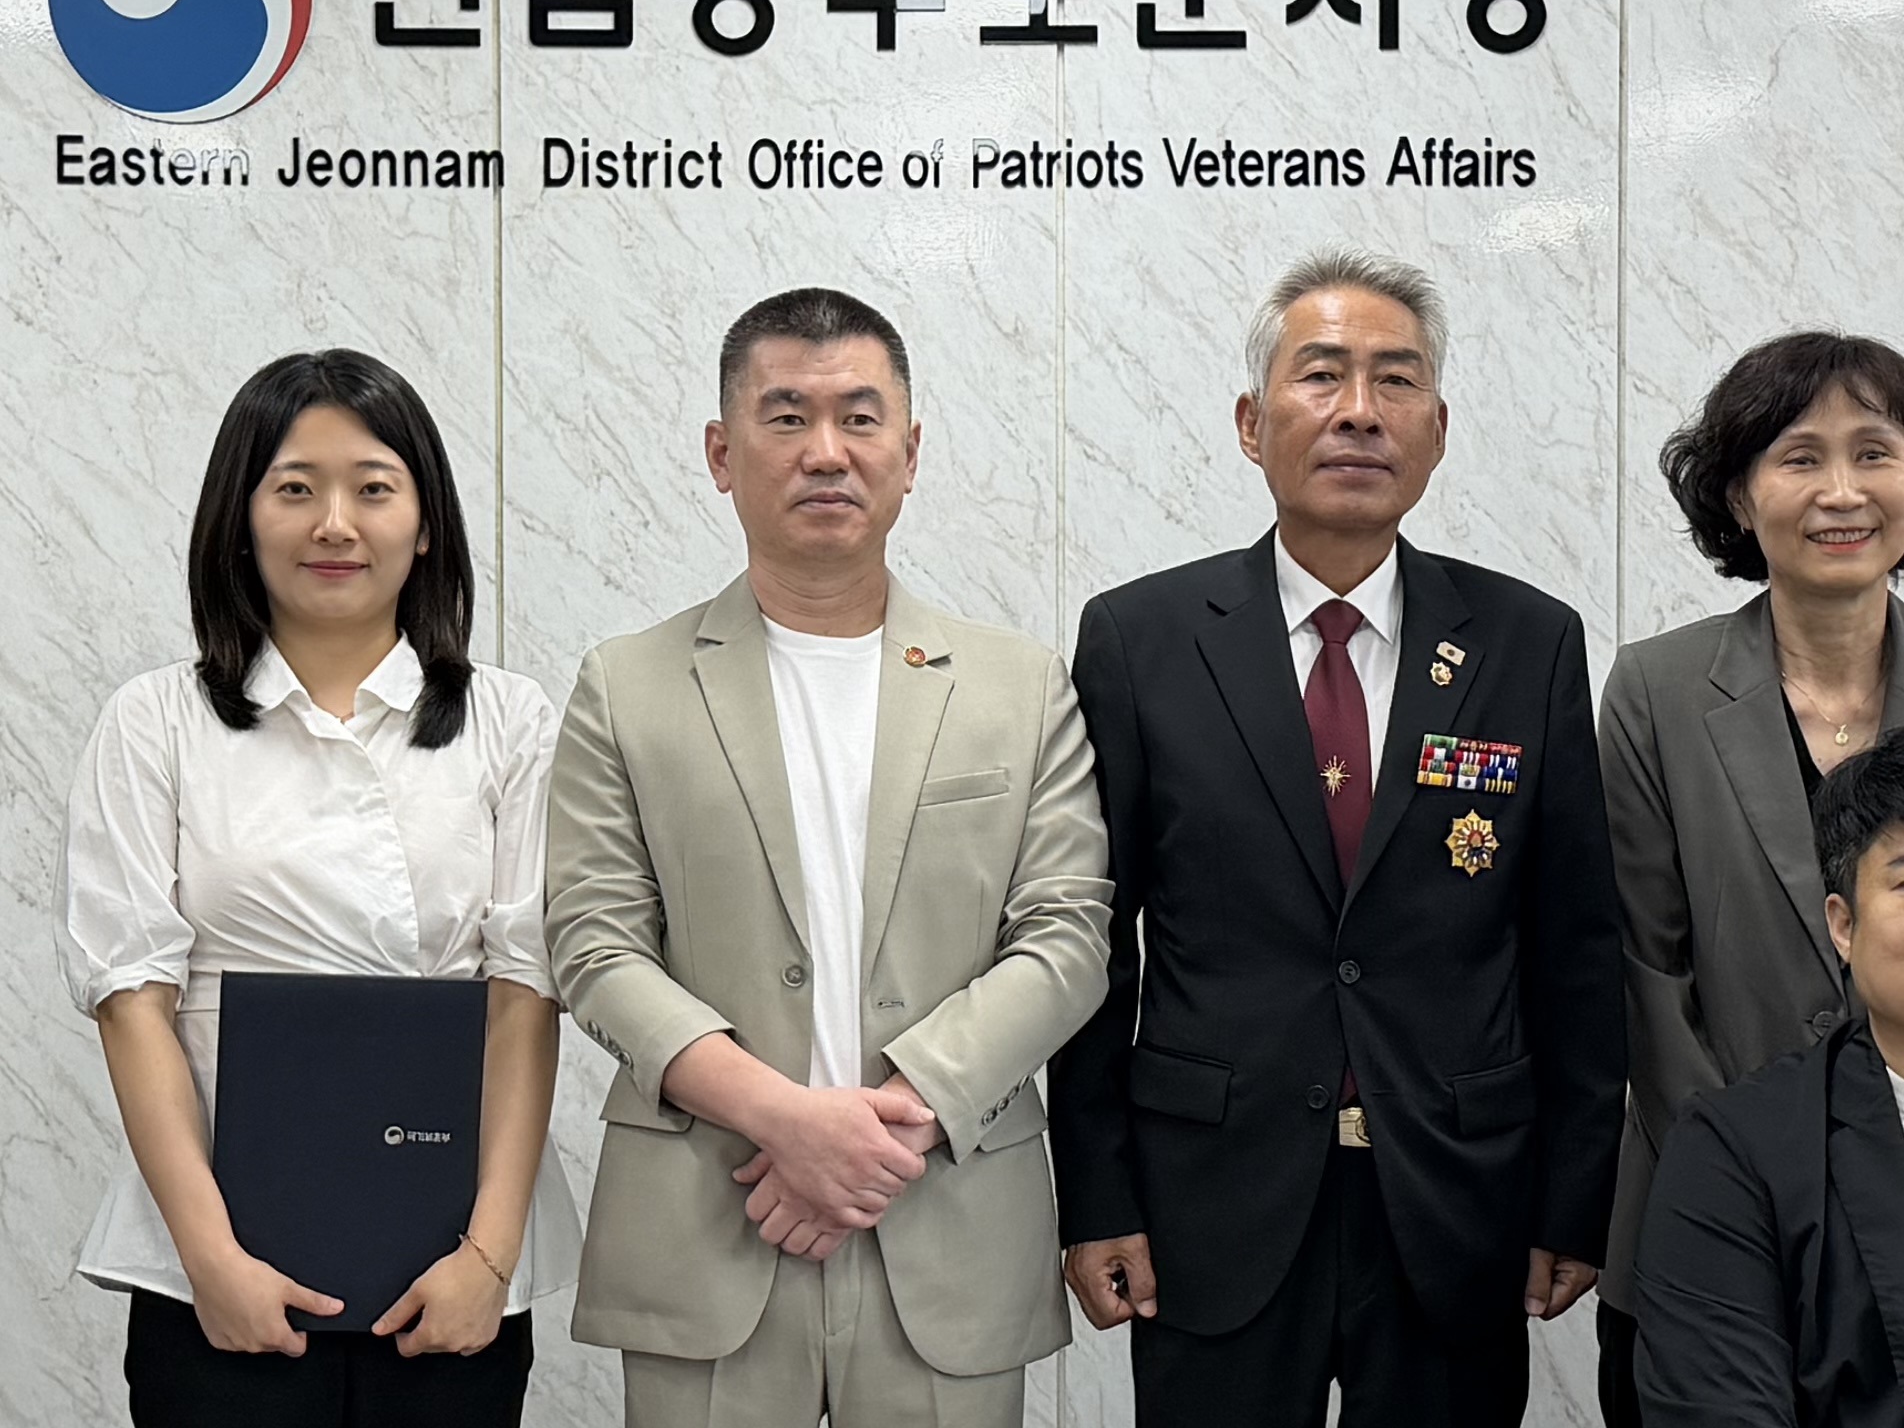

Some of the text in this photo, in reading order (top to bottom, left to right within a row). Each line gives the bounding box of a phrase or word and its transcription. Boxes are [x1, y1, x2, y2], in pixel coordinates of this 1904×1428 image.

[55, 134, 1540, 189] Eastern Jeonnam District Office of Patriots Veterans Affairs
